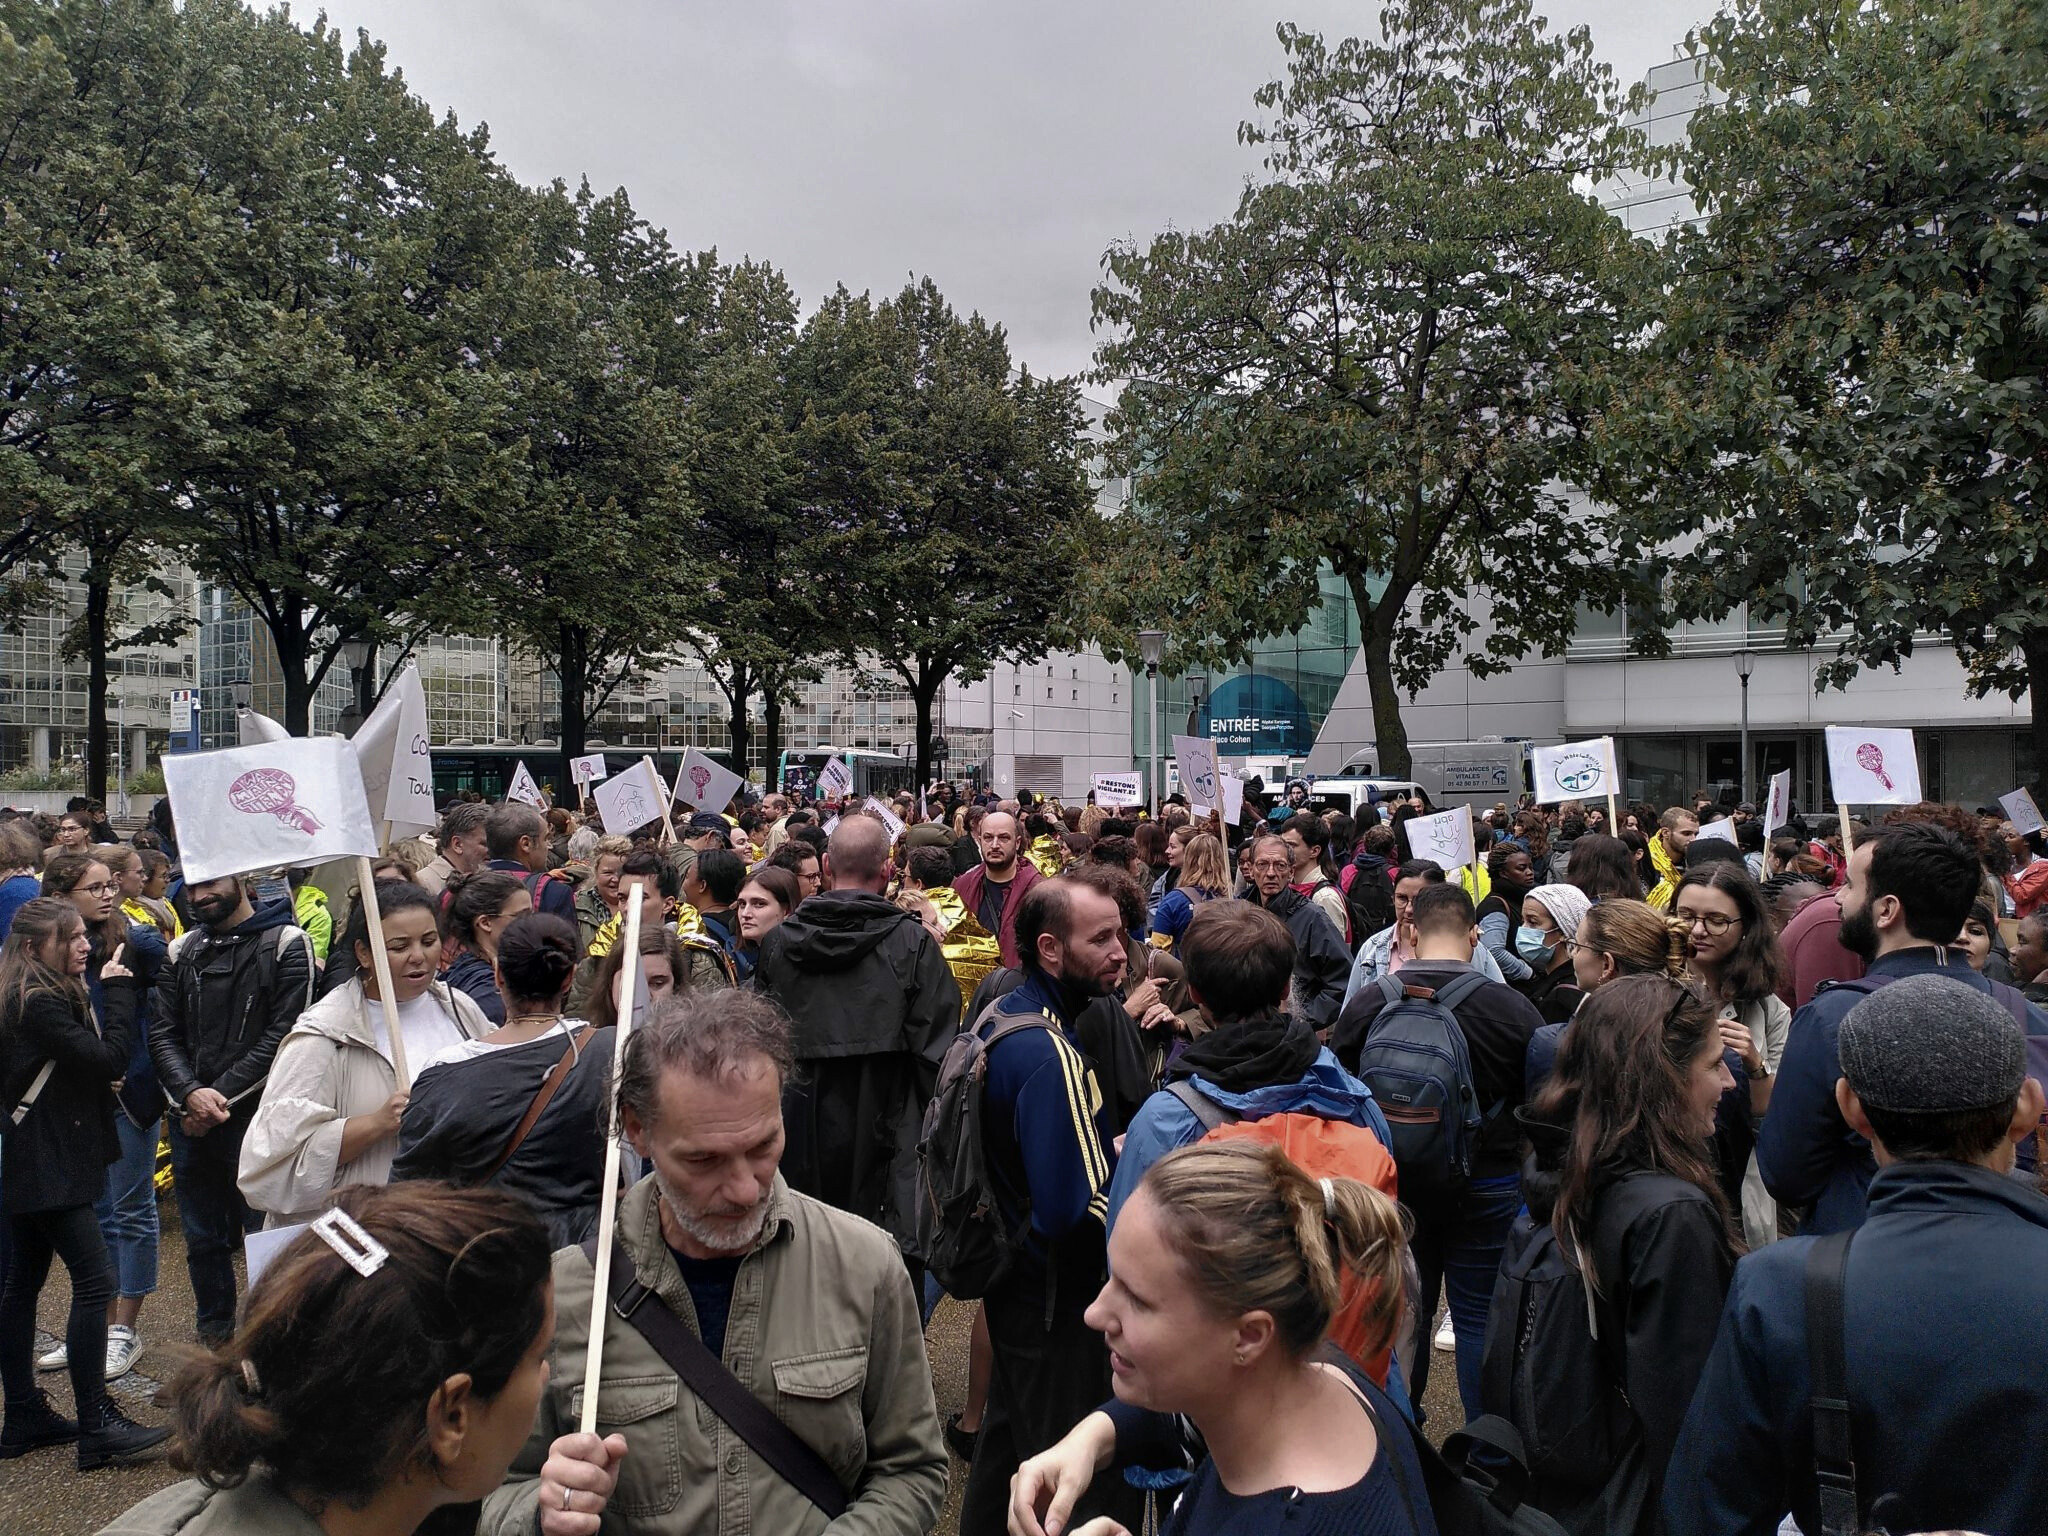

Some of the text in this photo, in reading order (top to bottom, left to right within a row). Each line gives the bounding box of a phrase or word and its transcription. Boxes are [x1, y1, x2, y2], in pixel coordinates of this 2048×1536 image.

[1210, 715, 1260, 732] ENTRÉE
[1229, 735, 1251, 743] Cohen
[627, 813, 645, 827] abri
[1434, 814, 1454, 827] abri
